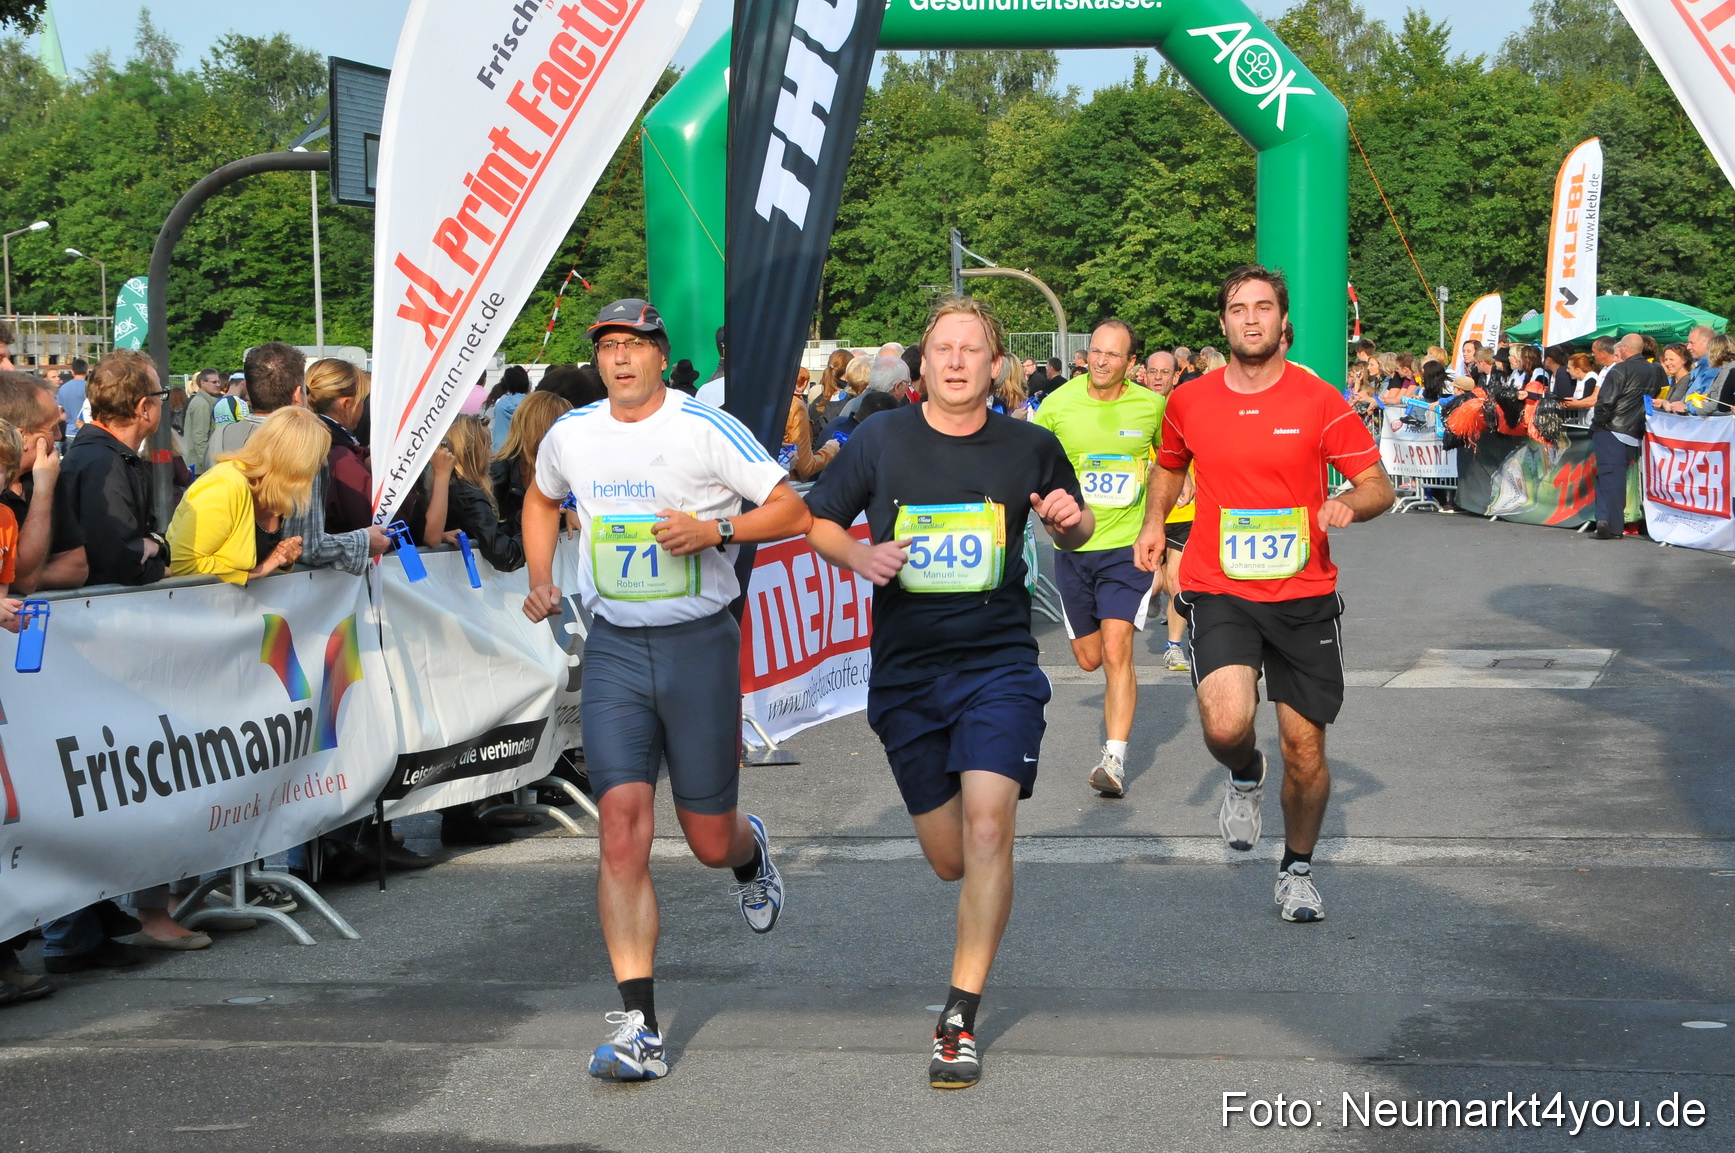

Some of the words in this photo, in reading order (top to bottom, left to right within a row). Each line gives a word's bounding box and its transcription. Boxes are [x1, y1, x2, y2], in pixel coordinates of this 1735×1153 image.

[1186, 22, 1317, 132] AOK
[394, 252, 464, 351] XL
[432, 126, 542, 276] Print
[506, 0, 635, 138] Facto
[1562, 162, 1586, 278] KLEBL
[1585, 173, 1600, 253] www.klebl.de
[374, 292, 505, 526] ww.frischmann-net.de
[593, 480, 656, 498] heinloth
[1084, 472, 1130, 494] 387
[1649, 441, 1724, 512] MEIER
[616, 544, 659, 578] 71
[908, 534, 983, 569] 549
[1225, 534, 1297, 560] 1137
[617, 580, 644, 588] Robert
[923, 571, 955, 579] Manuel
[767, 650, 872, 722] www.meier-baustoffe.d
[55, 706, 313, 819] Frischmann
[480, 737, 535, 762] verbinden
[207, 793, 262, 833] Druck
